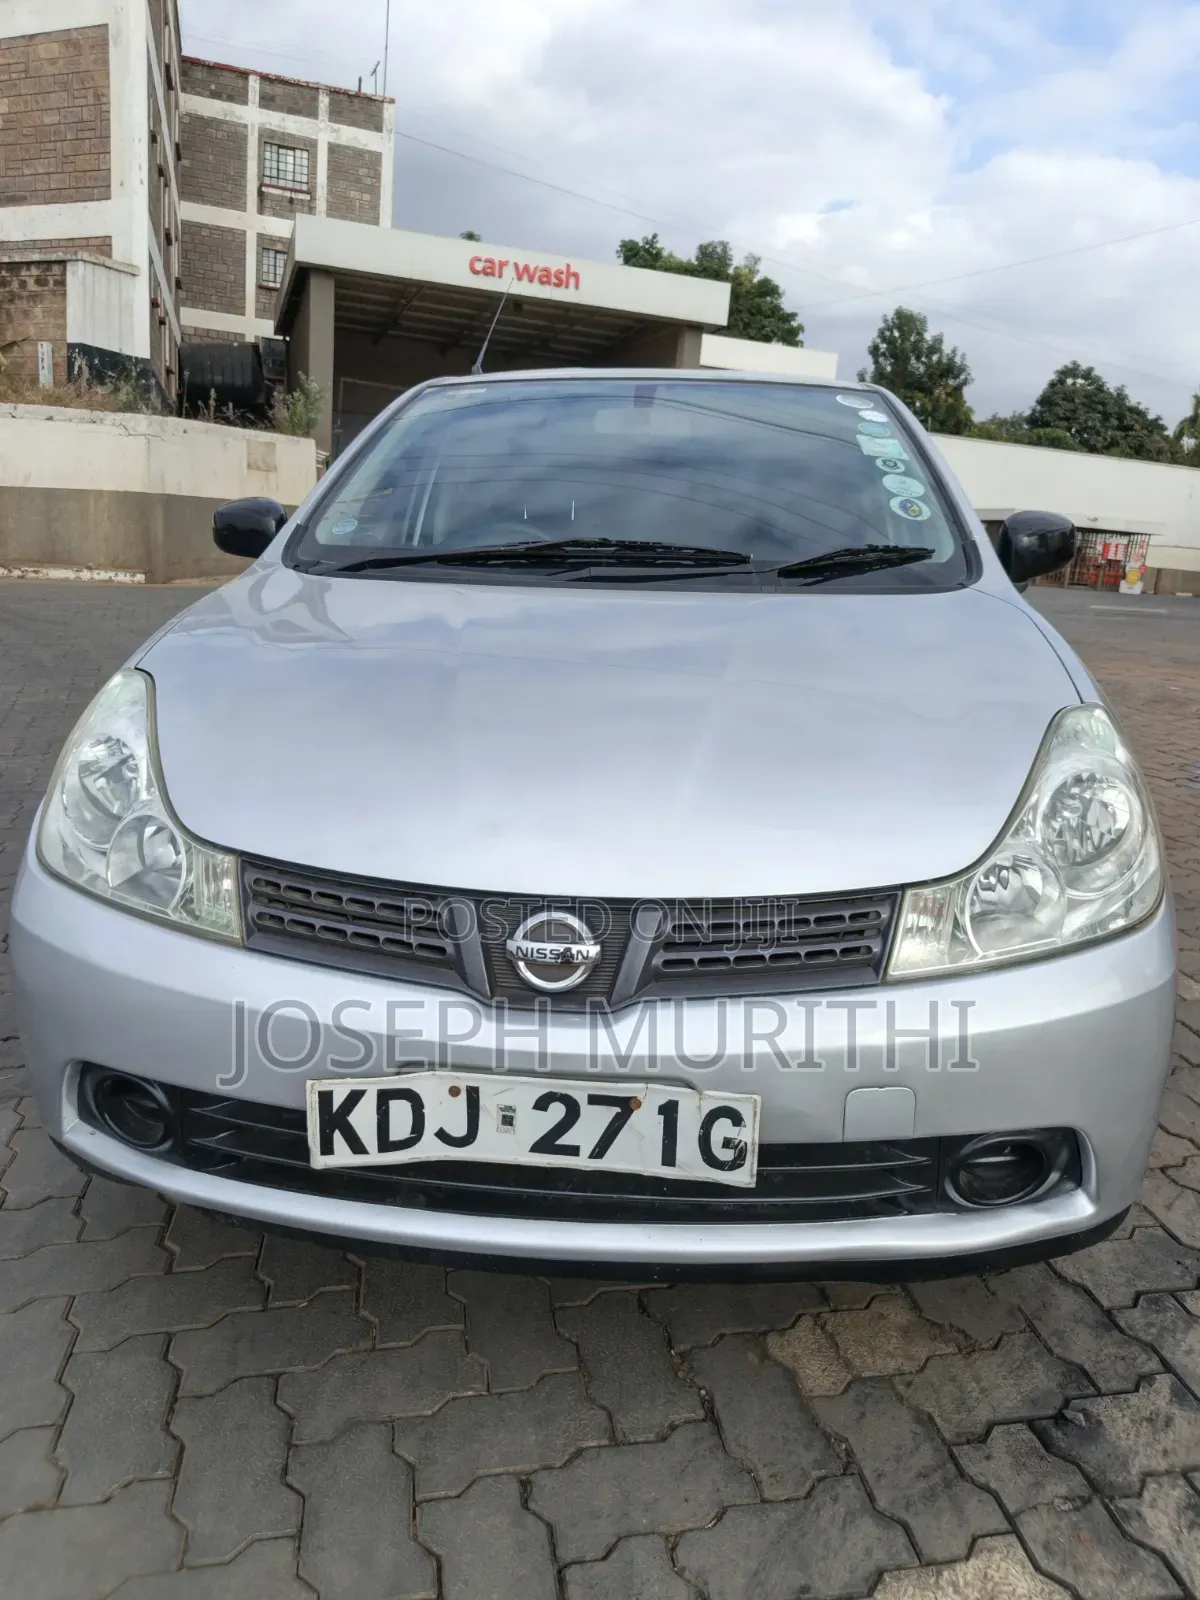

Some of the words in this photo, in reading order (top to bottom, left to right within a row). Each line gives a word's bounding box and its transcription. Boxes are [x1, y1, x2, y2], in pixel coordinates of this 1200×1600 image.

[469, 255, 509, 278] car
[513, 262, 581, 290] wash
[515, 945, 590, 961] NISSAN
[317, 1085, 480, 1156] KDJ
[528, 1090, 748, 1172] 271G
